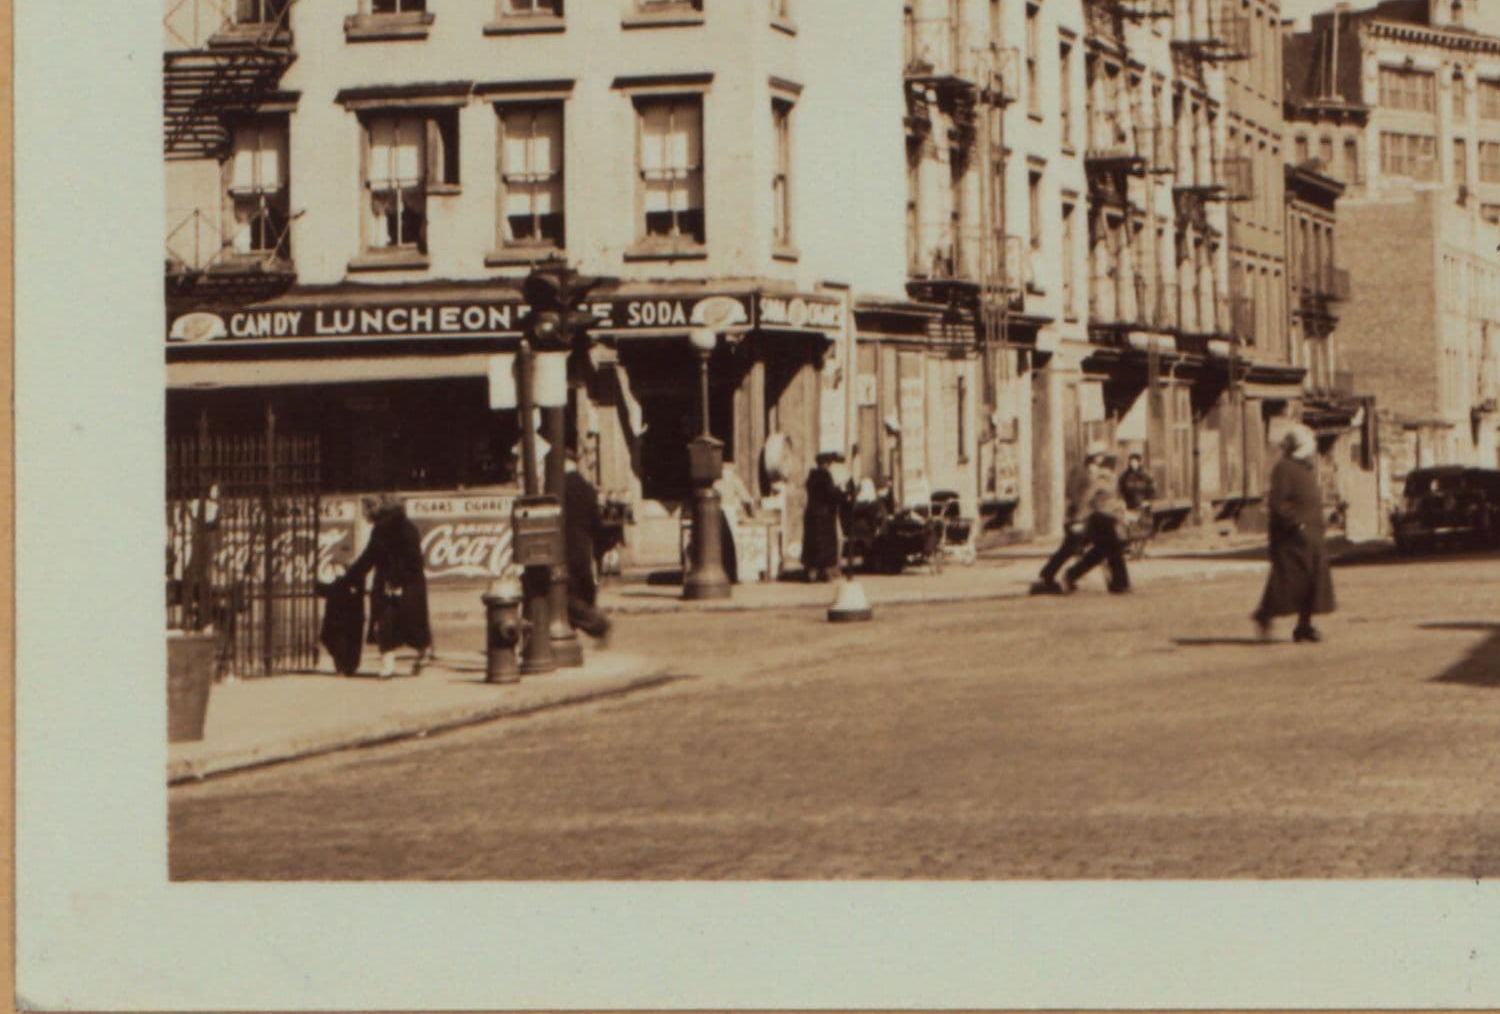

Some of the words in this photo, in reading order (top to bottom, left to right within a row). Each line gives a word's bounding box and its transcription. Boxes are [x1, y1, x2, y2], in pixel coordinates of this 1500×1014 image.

[230, 311, 302, 337] CANDY
[315, 303, 614, 335] LUNCHEONE
[627, 301, 687, 327] SODA
